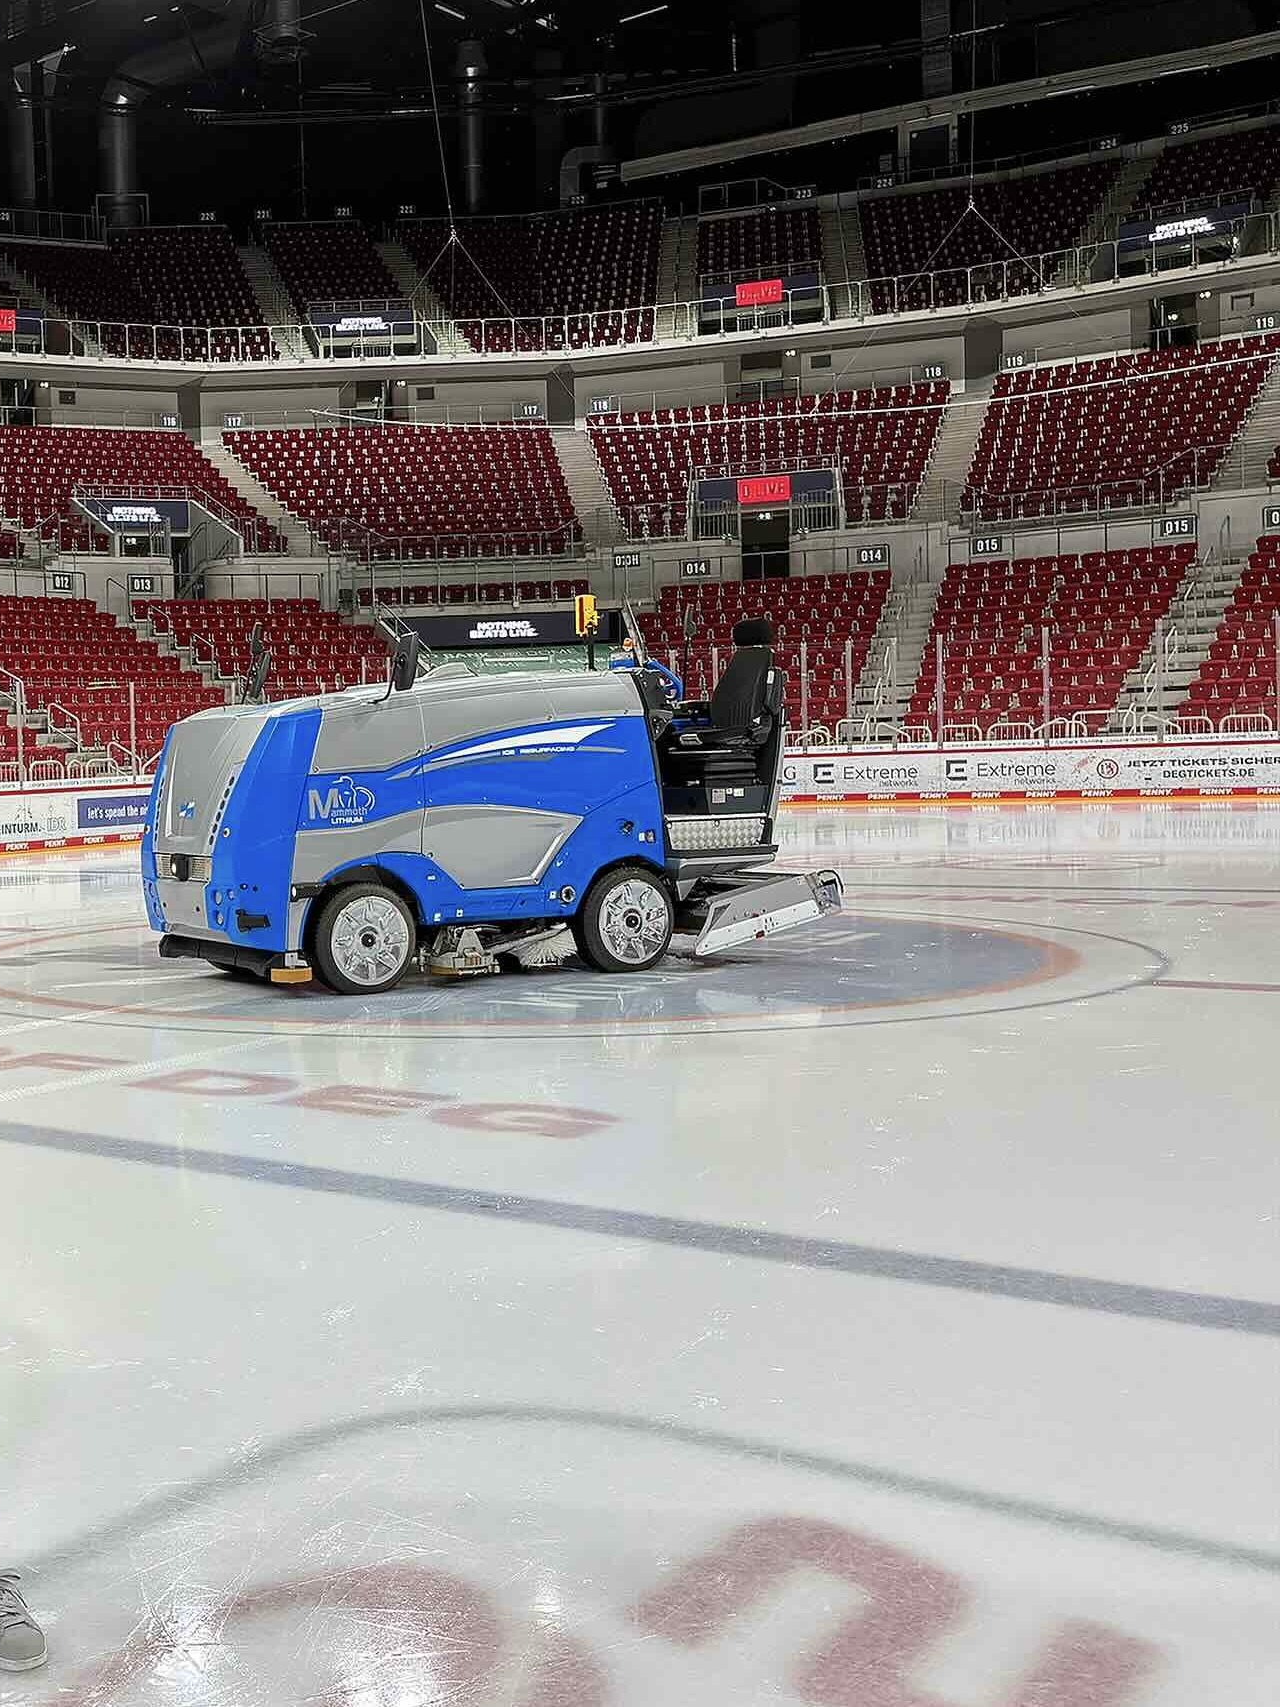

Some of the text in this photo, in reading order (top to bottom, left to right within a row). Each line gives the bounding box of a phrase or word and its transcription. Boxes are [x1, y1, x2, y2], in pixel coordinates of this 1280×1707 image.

[1256, 316, 1274, 329] 119
[1006, 356, 1023, 367] 119
[925, 366, 942, 378] 118
[523, 405, 538, 415] 117
[163, 416, 177, 427] 116
[227, 417, 242, 427] 117
[1166, 520, 1188, 533] 015
[977, 539, 998, 551] 015
[861, 549, 881, 563] 014
[686, 562, 705, 574] 014
[55, 576, 69, 588] 012
[133, 579, 151, 590] 013
[476, 620, 531, 631] NOTHING
[1127, 759, 1166, 768] JETZT
[1169, 757, 1226, 767] TICKETS
[843, 766, 919, 781] Extreme
[977, 762, 1057, 778] Extreme
[1163, 768, 1255, 779] DEGTICKETS.DE
[879, 779, 919, 787] networks
[1014, 777, 1057, 786] networks
[308, 788, 368, 820] Mammoth
[87, 806, 104, 820] let's
[105, 806, 126, 820] spend
[127, 804, 139, 817] the
[331, 816, 364, 825] LITHIUM
